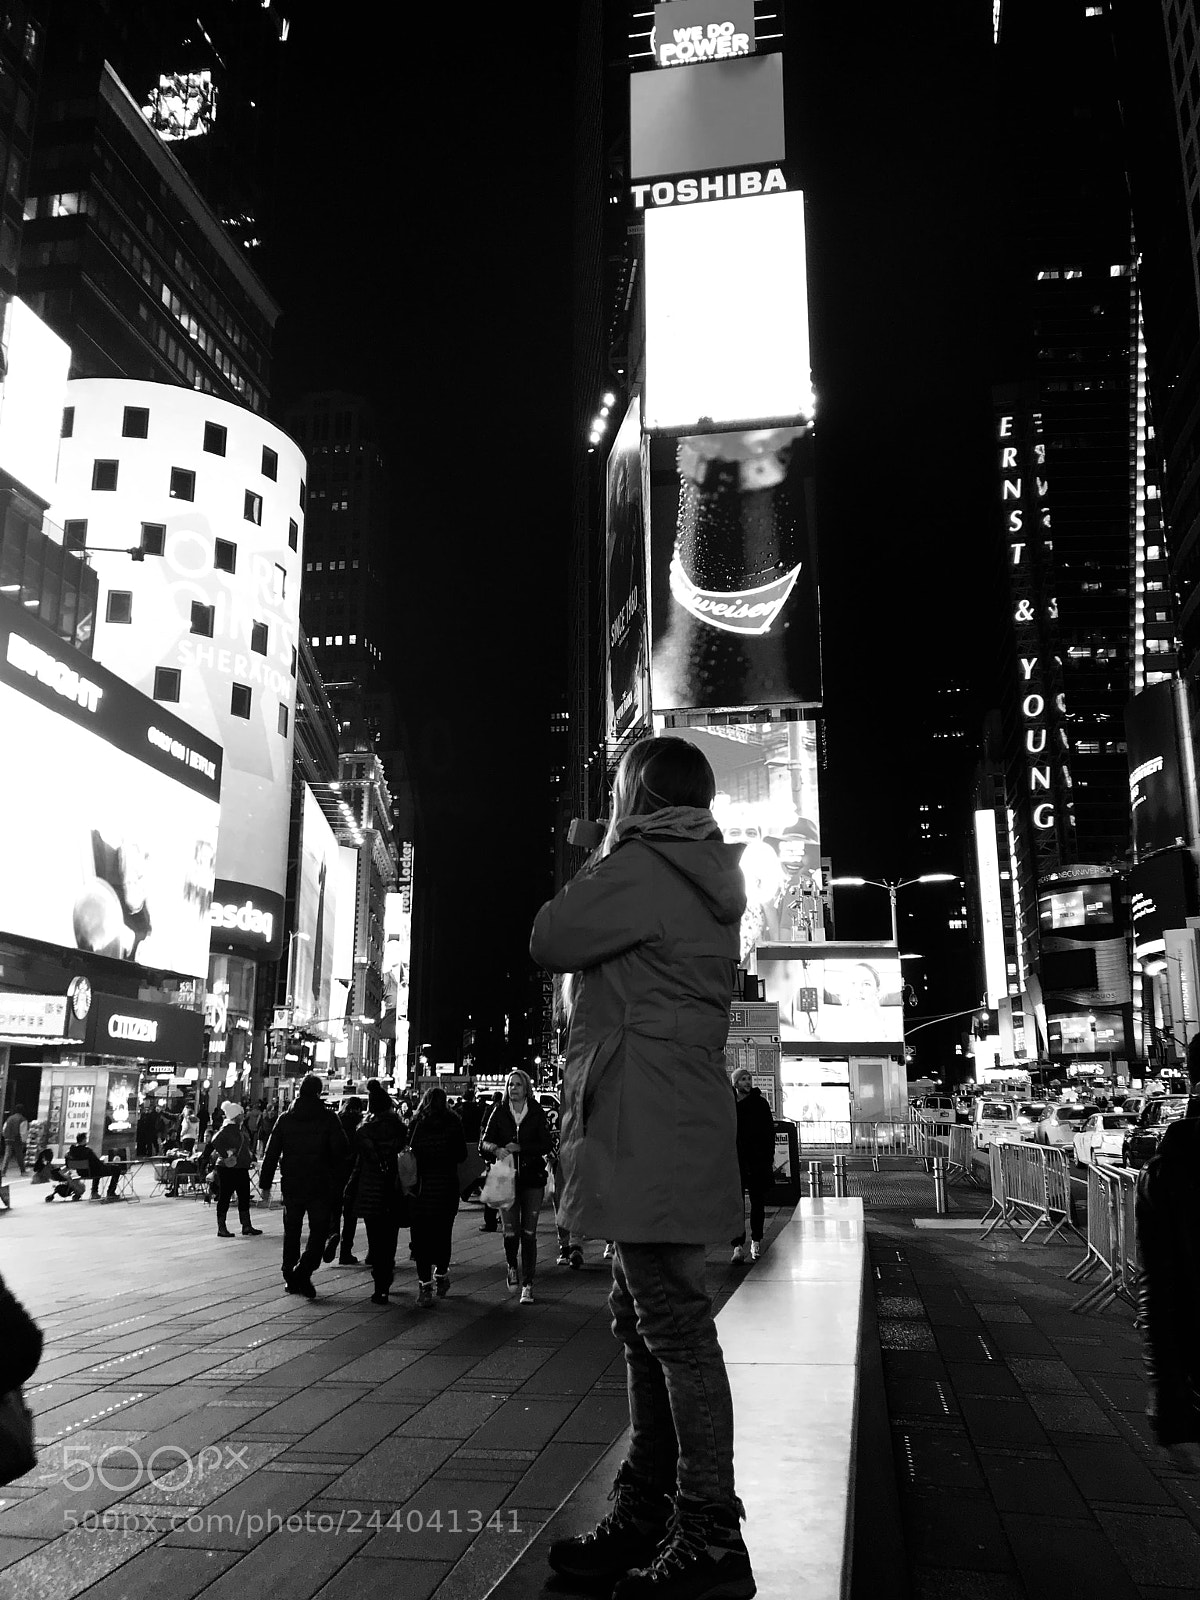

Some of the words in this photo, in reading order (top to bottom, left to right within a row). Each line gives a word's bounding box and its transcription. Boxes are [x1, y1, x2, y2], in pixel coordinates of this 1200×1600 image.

[672, 25, 704, 43] WE
[707, 21, 735, 39] DO
[660, 33, 750, 65] POWER
[630, 167, 787, 208] TOSHIBA
[998, 415, 1026, 566] ERNST
[1014, 598, 1034, 622] &
[176, 638, 292, 700] SHERATON
[1020, 656, 1056, 830] YOUNG
[189, 750, 217, 781] NETFLIX
[399, 841, 412, 882] Locker
[209, 900, 274, 943] asdaq
[108, 1013, 159, 1043] CITIZEN
[149, 1065, 175, 1073] CITIZEN
[67, 1111, 89, 1120] Candy
[68, 1100, 90, 1108] Drink
